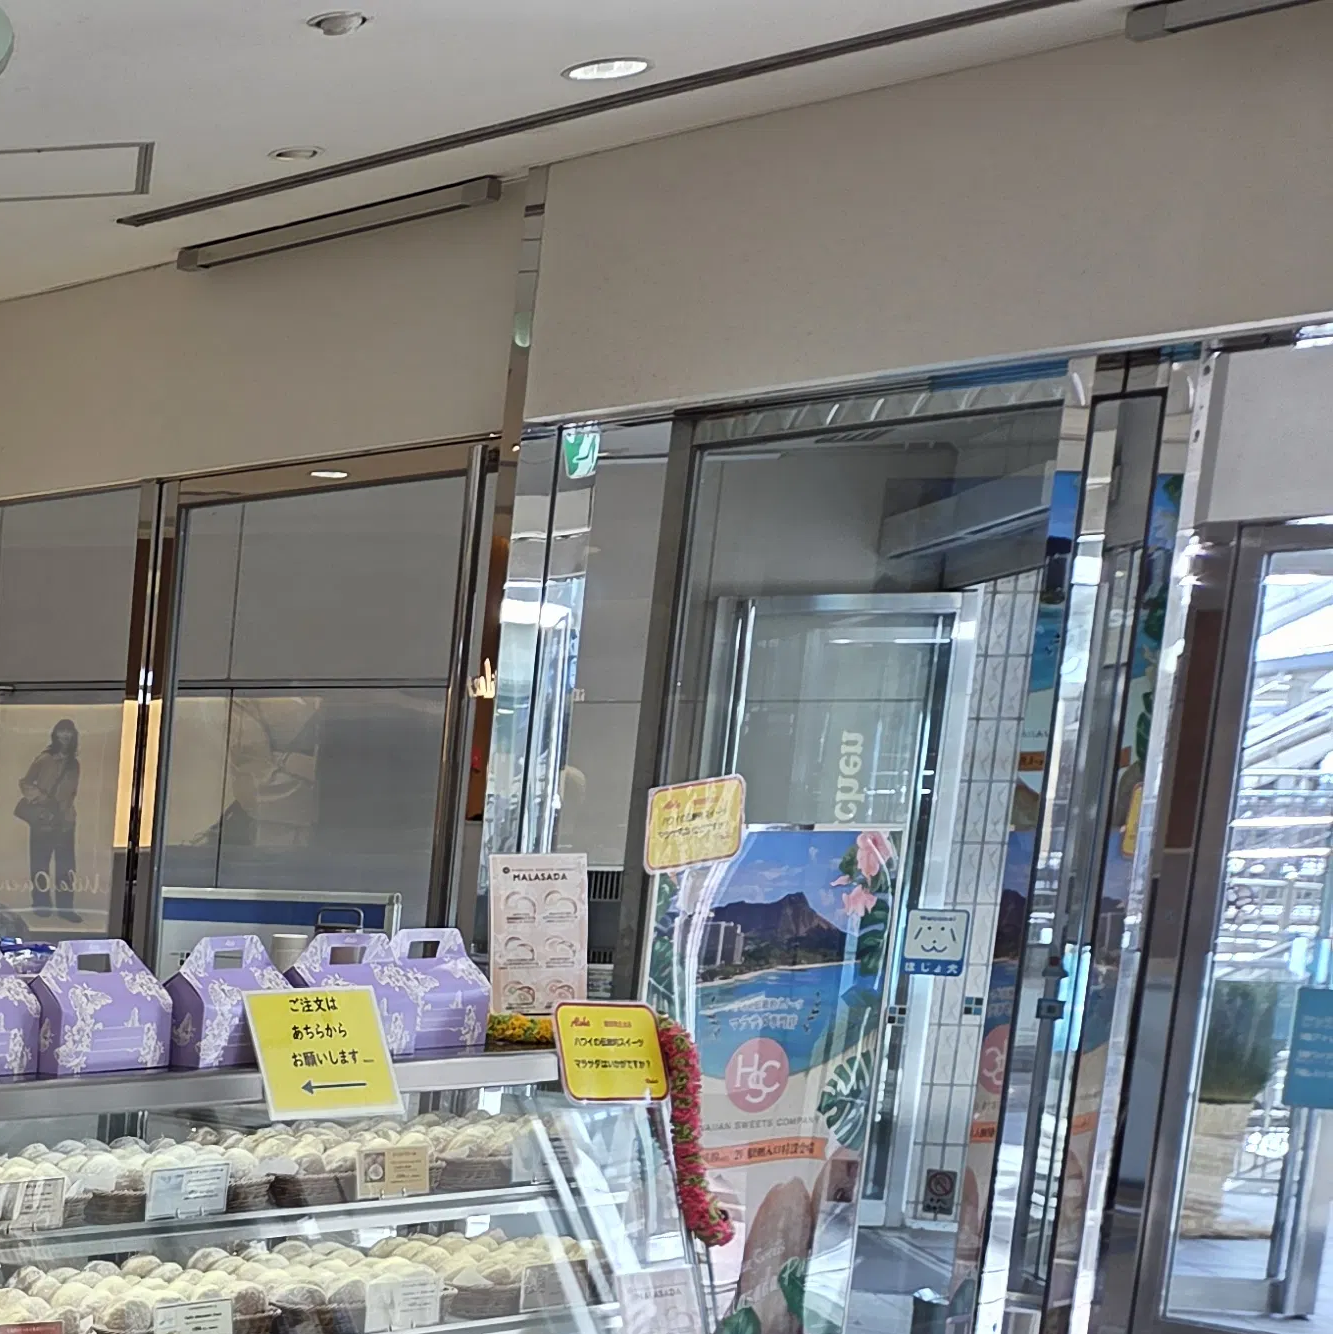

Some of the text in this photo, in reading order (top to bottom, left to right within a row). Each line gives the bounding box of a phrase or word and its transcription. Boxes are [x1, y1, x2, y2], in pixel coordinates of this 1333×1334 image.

[512, 871, 568, 882] MALASADA
[288, 996, 338, 1013] ご注文は
[291, 1022, 348, 1040] あちらから
[291, 1048, 359, 1068] お願いします
